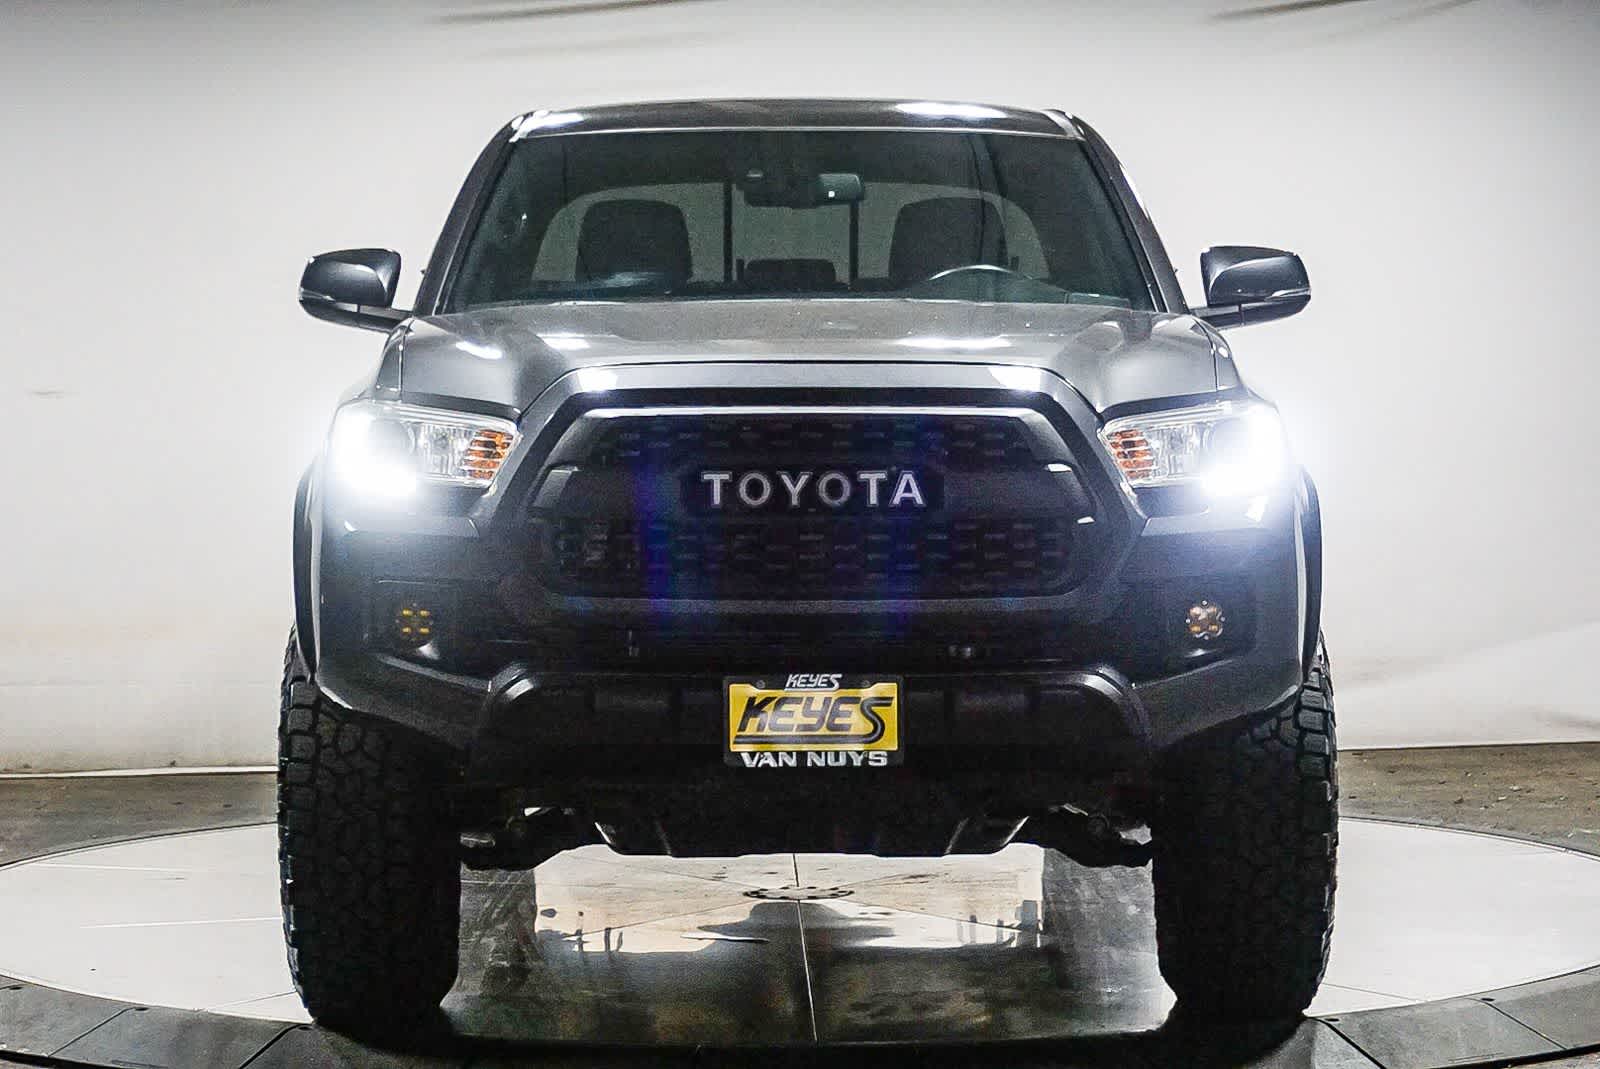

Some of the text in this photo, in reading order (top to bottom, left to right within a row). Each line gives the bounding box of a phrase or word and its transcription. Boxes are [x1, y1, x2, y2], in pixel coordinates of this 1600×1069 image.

[701, 471, 926, 506] TOYOTA
[784, 673, 842, 691] KEYES
[733, 696, 894, 744] KEYES
[740, 751, 888, 767] VAN NUYS
